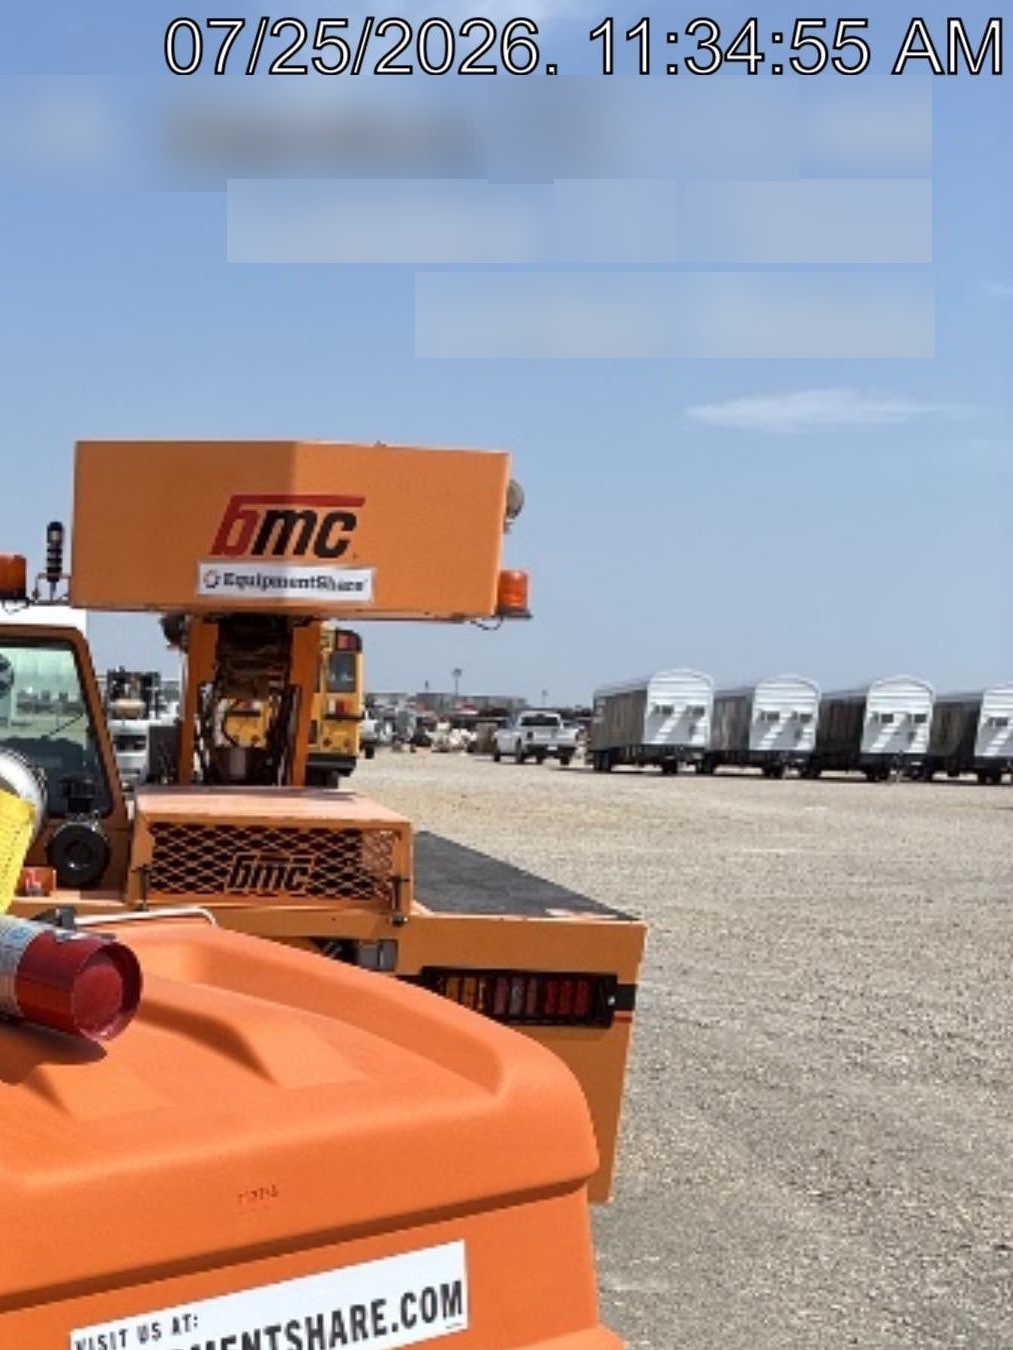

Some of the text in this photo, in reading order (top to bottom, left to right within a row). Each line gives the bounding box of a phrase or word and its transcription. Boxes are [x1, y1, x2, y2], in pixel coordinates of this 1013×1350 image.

[209, 495, 365, 558] bmc
[228, 853, 310, 897] bmc
[137, 1322, 162, 1344] US
[172, 1313, 198, 1335] AT:
